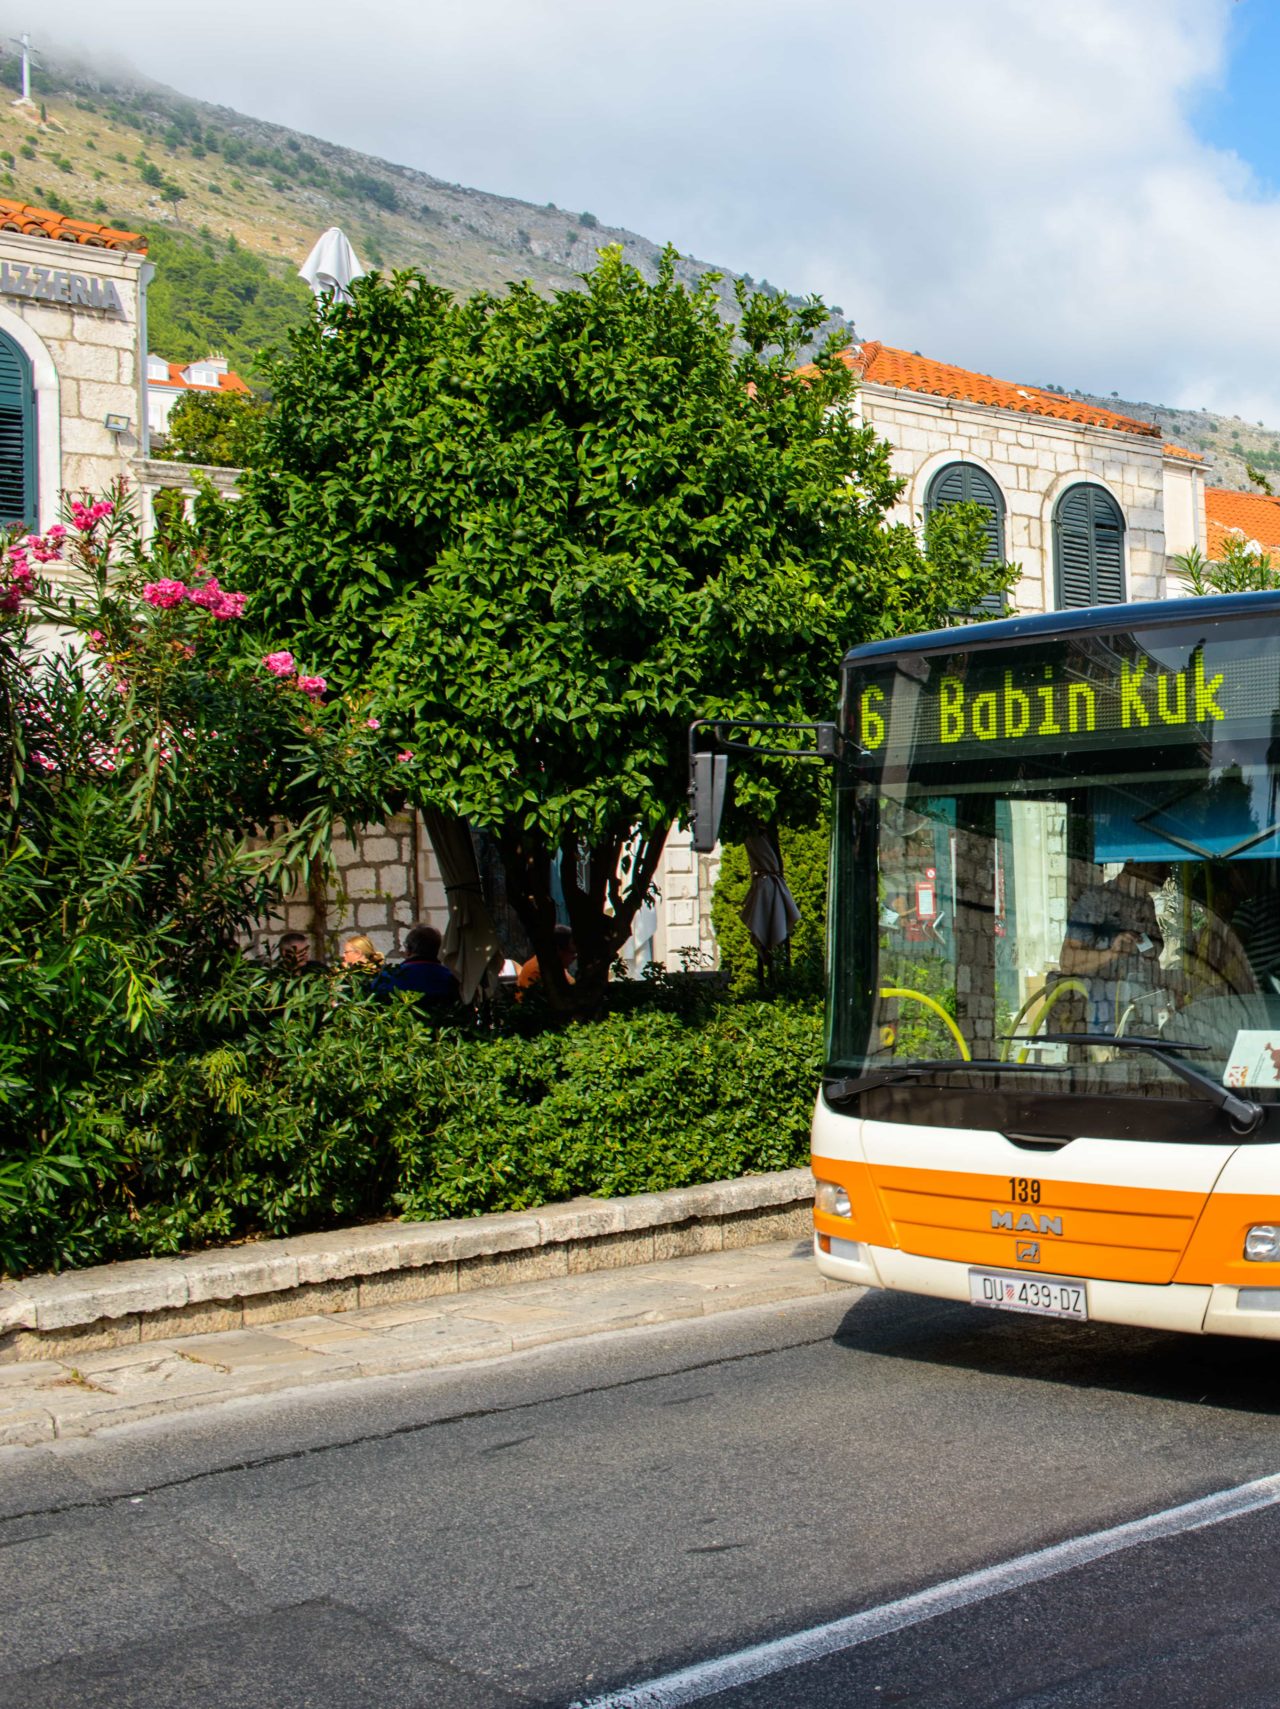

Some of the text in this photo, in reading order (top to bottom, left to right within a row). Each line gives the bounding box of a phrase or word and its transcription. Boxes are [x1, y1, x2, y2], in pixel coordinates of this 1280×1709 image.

[0, 262, 122, 311] IZZERIA
[860, 648, 1225, 750] 6 Babin Kuk
[1009, 1177, 1041, 1204] 139
[991, 1210, 1064, 1237] MAN
[983, 1277, 1004, 1302] DU
